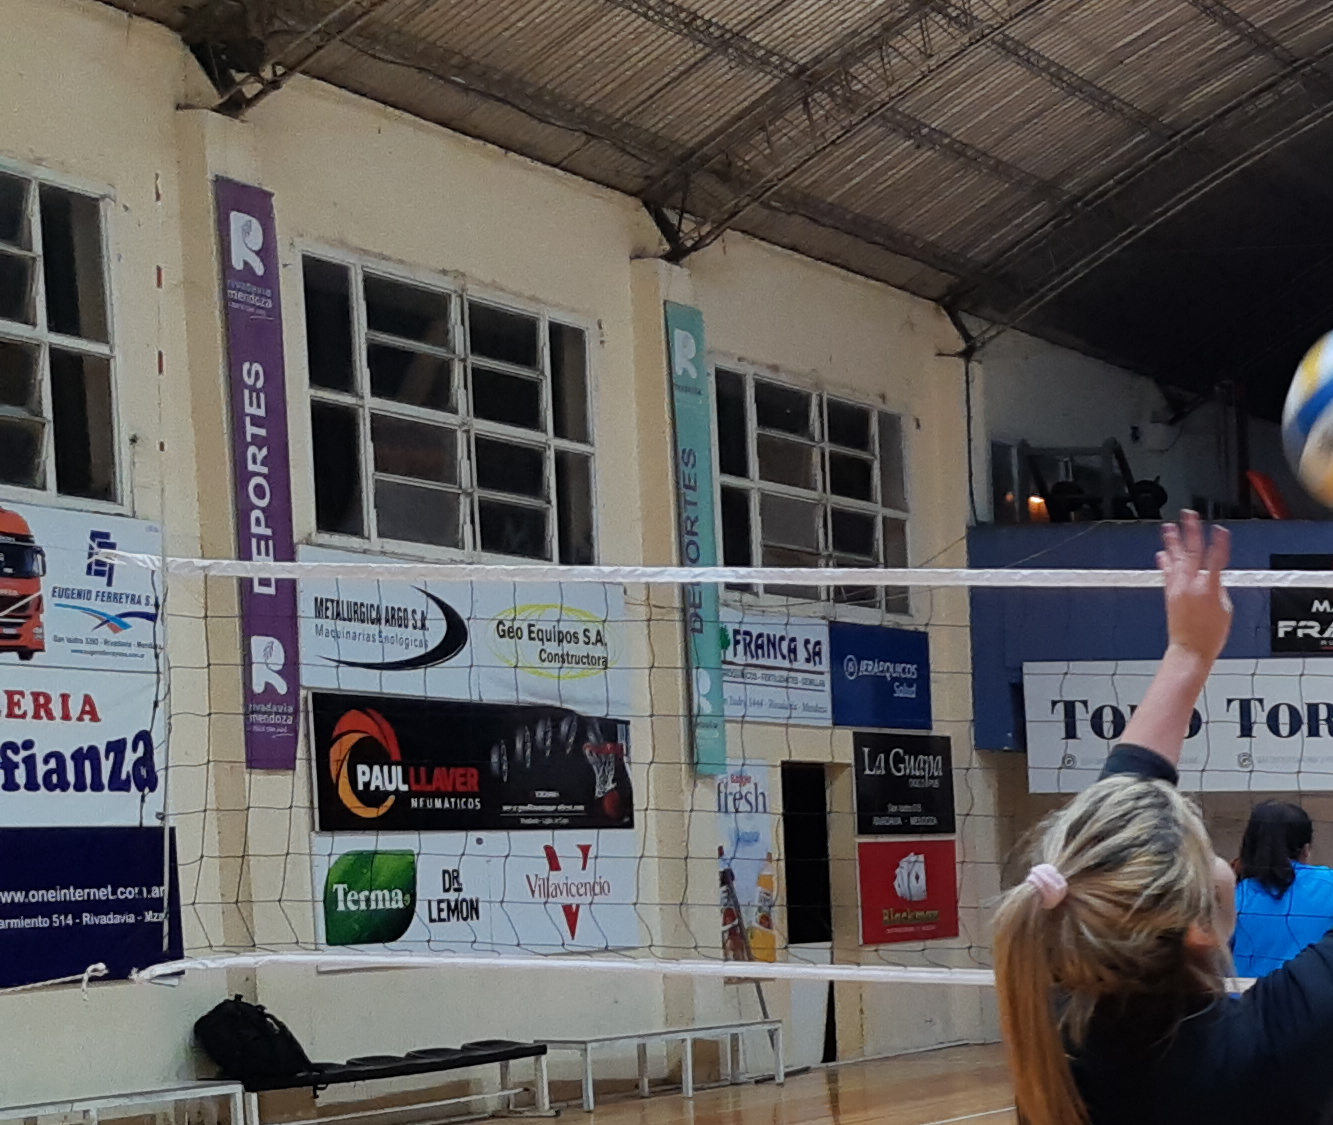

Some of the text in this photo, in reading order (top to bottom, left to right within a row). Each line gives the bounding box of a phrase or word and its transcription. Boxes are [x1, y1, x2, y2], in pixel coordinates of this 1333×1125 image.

[242, 361, 277, 595] DEPORTES
[682, 447, 704, 634] DEORTES
[52, 586, 92, 601] EUGENIO
[95, 590, 142, 606] FERREYRA
[314, 596, 382, 626] METALURGICA
[384, 605, 409, 630] ARGO
[496, 619, 523, 641] Geo
[528, 623, 580, 647] Equipos
[732, 629, 799, 667] FRANCA
[538, 648, 608, 670] Constructora
[0, 690, 102, 723] ERIA
[1051, 699, 1202, 740] TOO
[356, 764, 480, 792] PAUL LLAVER
[862, 747, 943, 788] La Guapa
[717, 776, 768, 815] fresh
[332, 884, 405, 912] Terma
[525, 873, 611, 899] Villavicencio
[52, 913, 73, 927] 514
[82, 910, 136, 926] Rivadavia
[428, 898, 480, 923] LEMON
